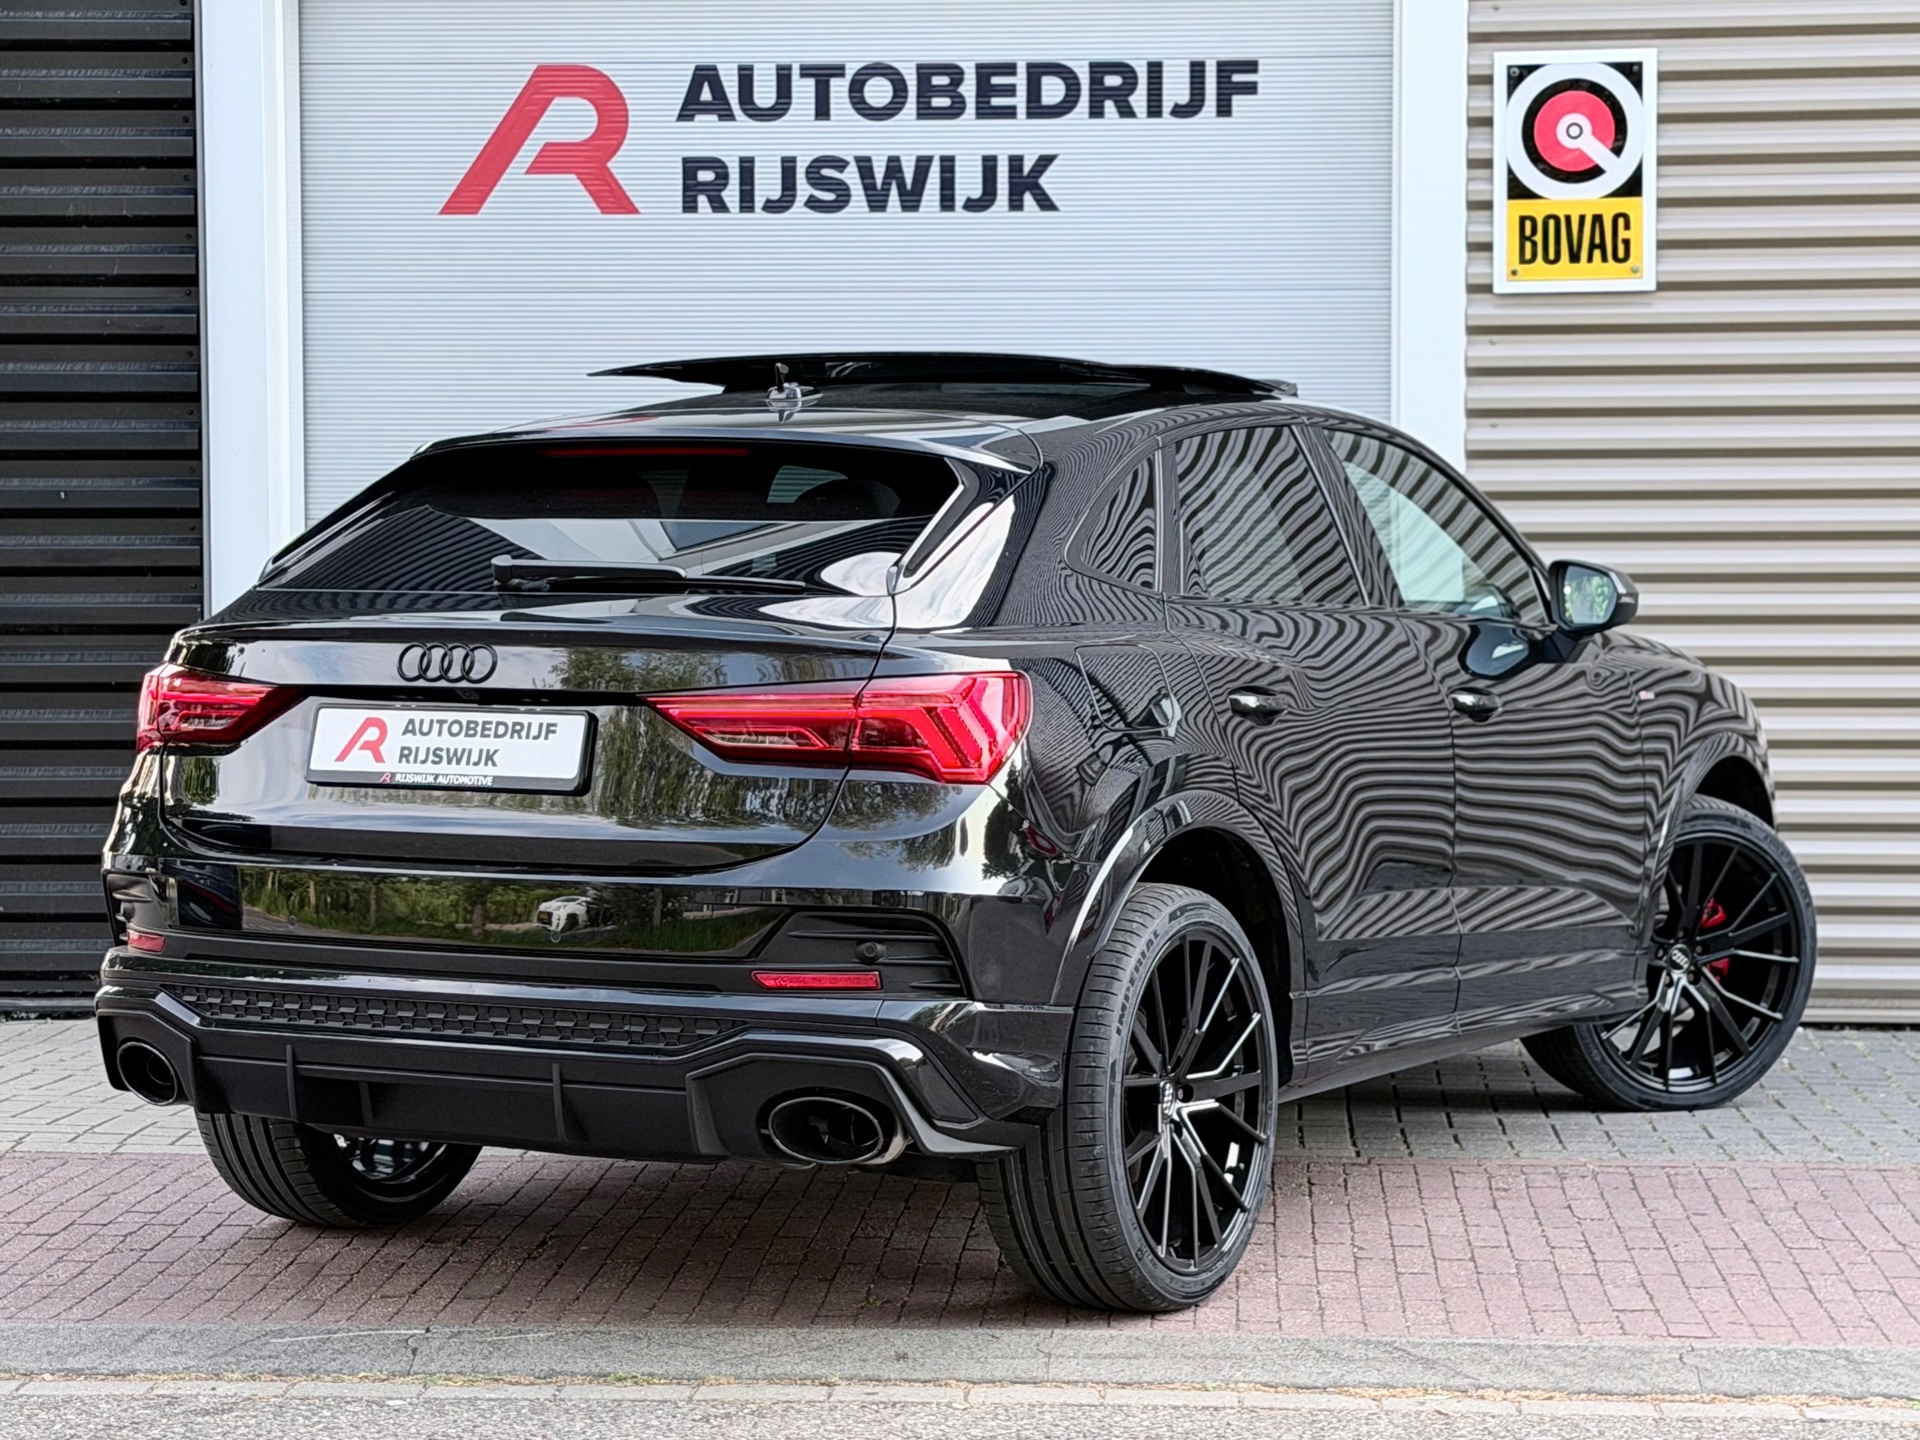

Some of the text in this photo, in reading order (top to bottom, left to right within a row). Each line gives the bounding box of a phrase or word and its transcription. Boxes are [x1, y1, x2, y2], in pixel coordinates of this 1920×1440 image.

[676, 59, 1259, 122] AUTOBEDRIJF
[681, 153, 1060, 215] RIJSWIJK
[1518, 212, 1632, 265] BOVAG
[401, 718, 559, 741] AUTOBEDRIJF
[395, 773, 436, 784] RIJSWIJK
[436, 775, 494, 786] AUTOMOTIVE
[398, 746, 500, 767] RIJSWIJK
[1116, 929, 1160, 1037] IMPERIAL
